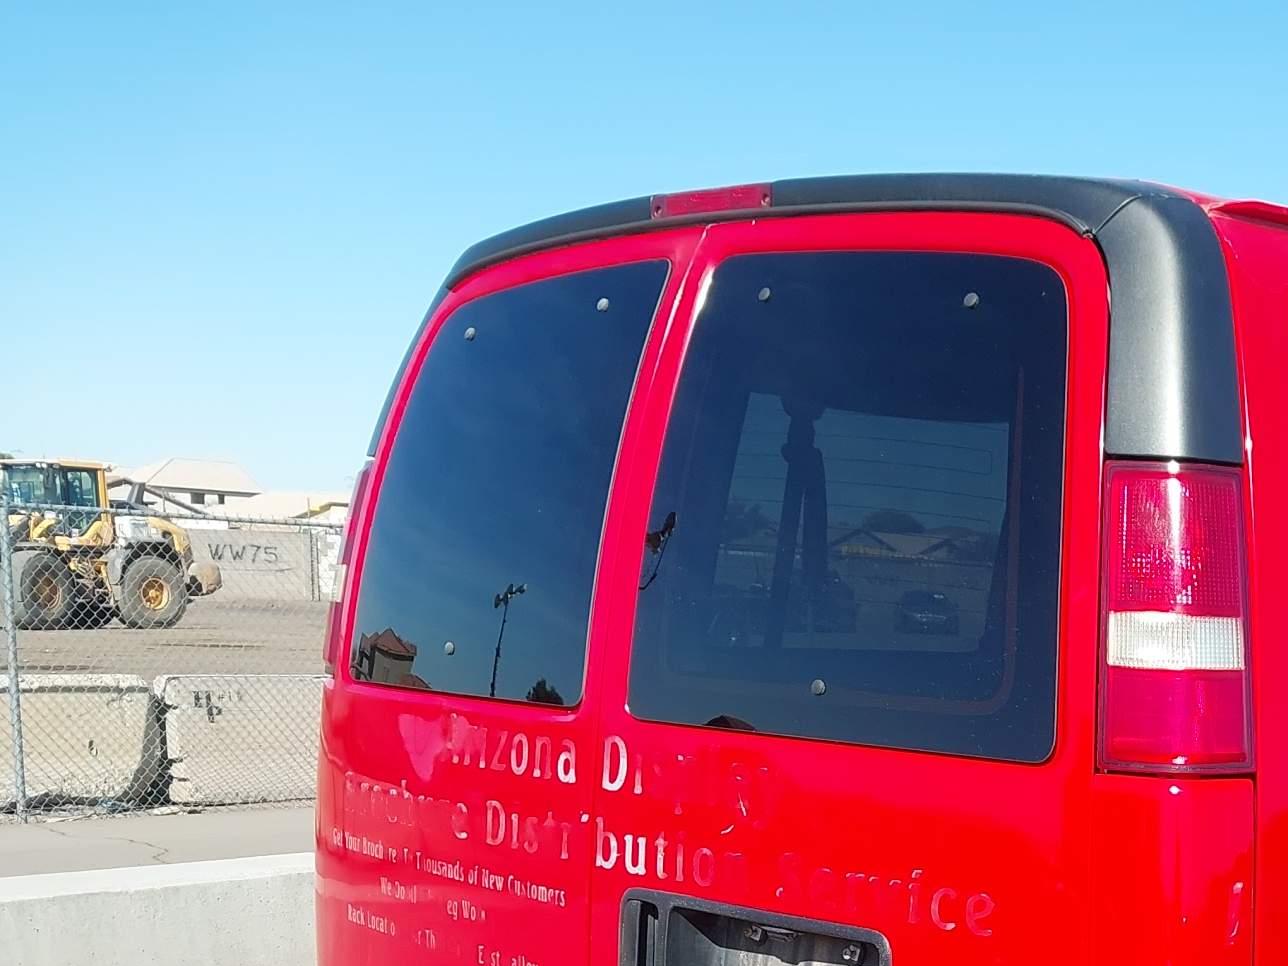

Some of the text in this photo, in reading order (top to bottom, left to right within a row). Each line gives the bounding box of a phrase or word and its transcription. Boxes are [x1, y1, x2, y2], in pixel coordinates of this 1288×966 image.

[208, 543, 278, 563] WW75
[345, 831, 361, 853] Your
[362, 836, 397, 863] Brochre
[468, 865, 479, 886] of
[481, 868, 505, 892] New
[347, 903, 366, 926] Rack
